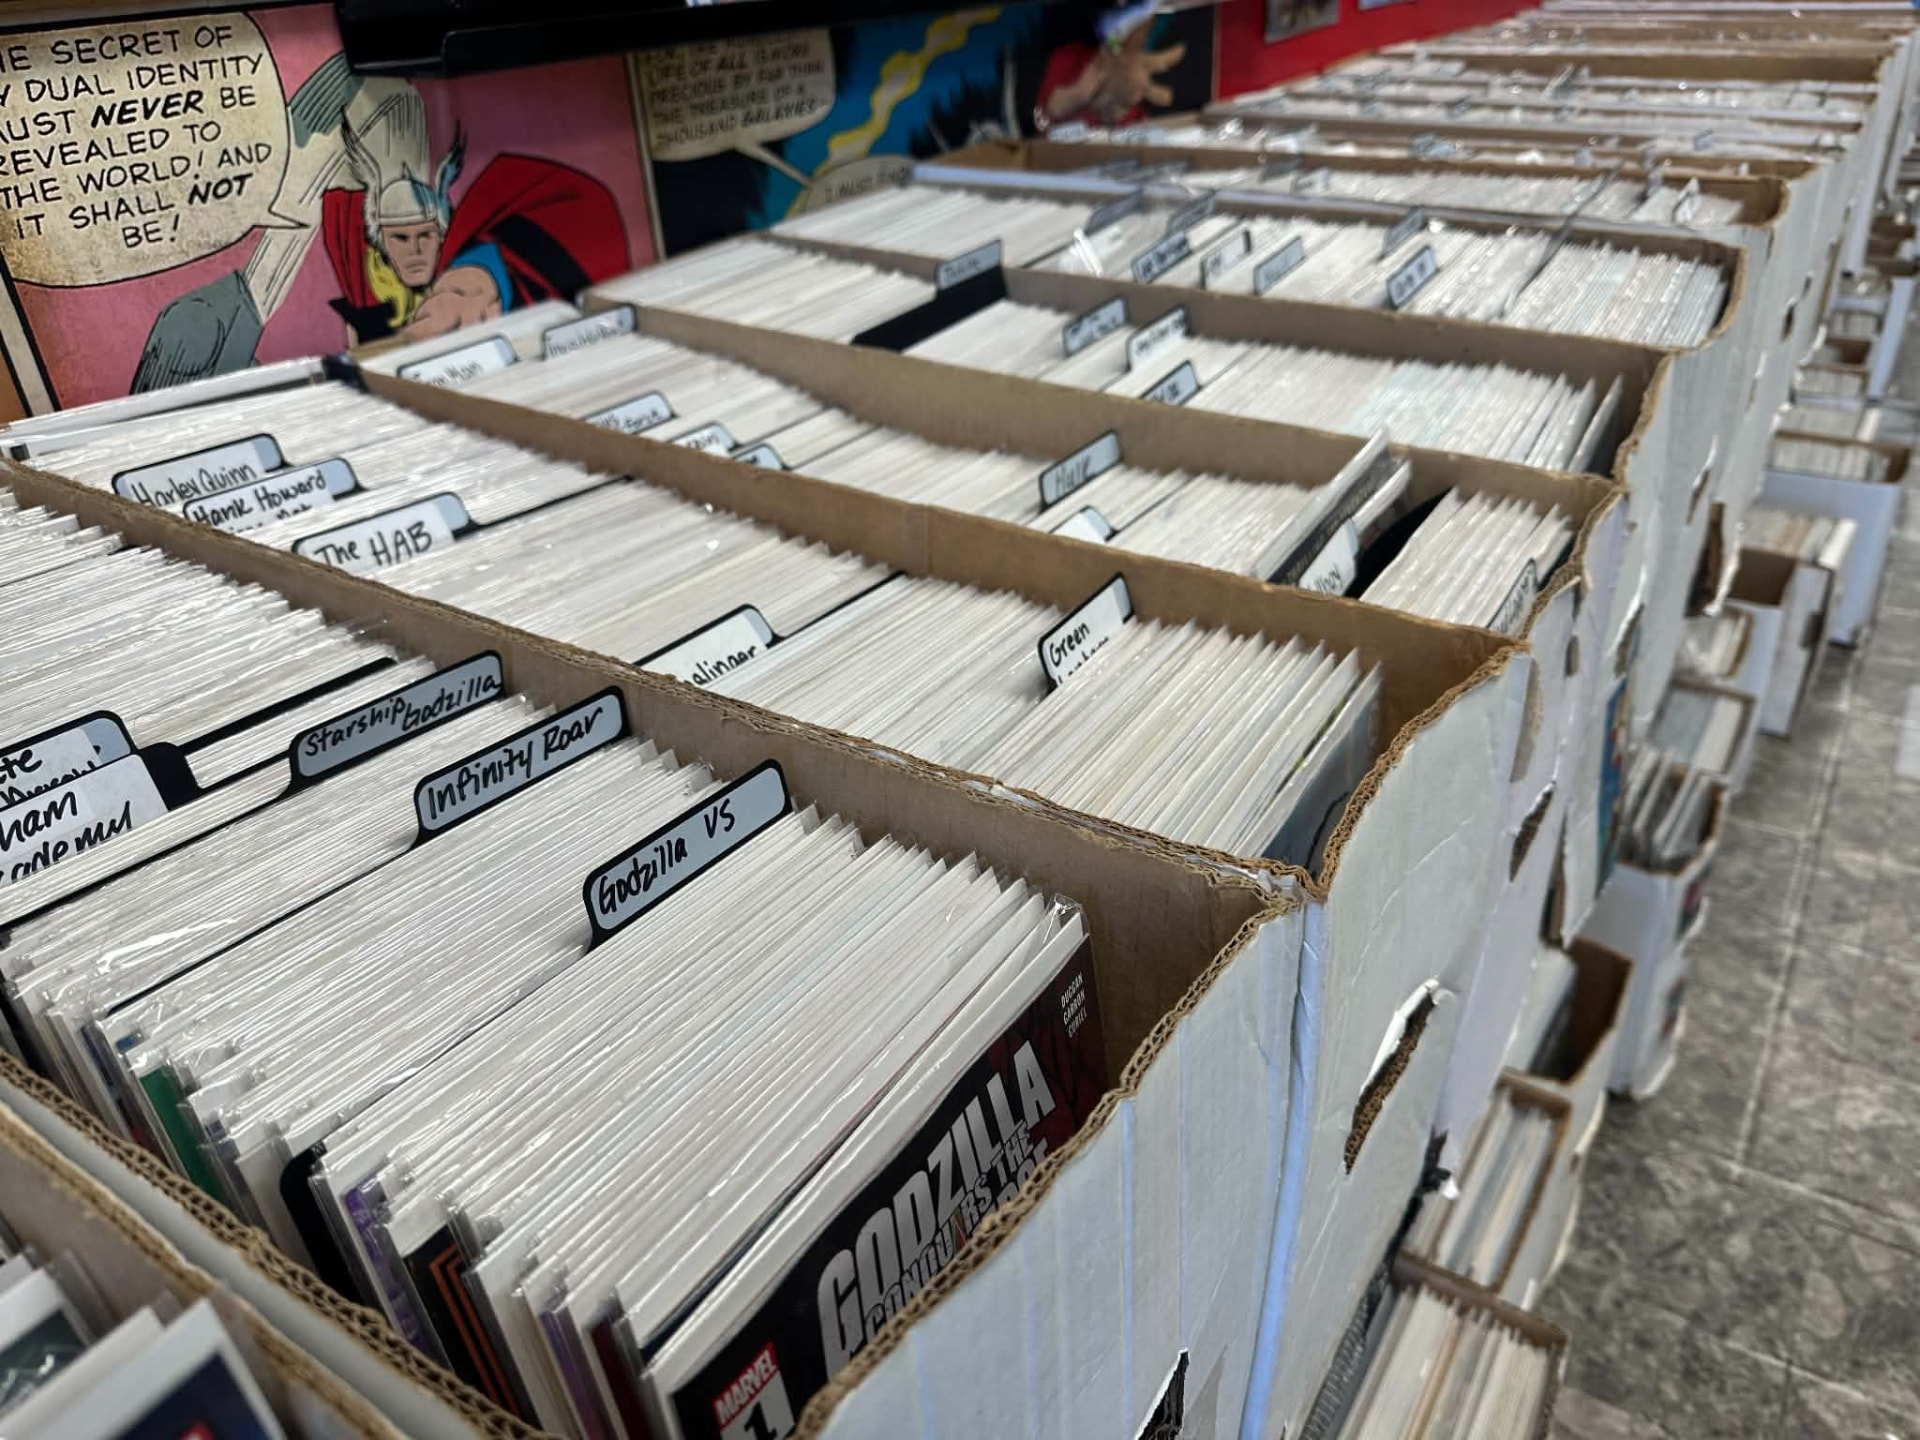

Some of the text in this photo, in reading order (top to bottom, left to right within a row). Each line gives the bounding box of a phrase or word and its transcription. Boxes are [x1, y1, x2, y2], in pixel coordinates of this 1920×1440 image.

[50, 29, 181, 65] SECRET
[194, 25, 233, 49] OF
[25, 74, 115, 103] DUAL
[126, 53, 263, 91] IDENTITY
[91, 89, 205, 129] NEVER
[220, 85, 257, 110] BE
[182, 121, 222, 145] TO
[0, 143, 272, 211] THE WORLD! AND
[16, 174, 253, 241] IT SHALL NOT
[122, 214, 181, 250] BE!
[131, 464, 258, 509] Harley Quinn
[192, 498, 253, 526] Hank
[254, 470, 326, 512] Howard
[313, 520, 432, 568] The HAB
[1050, 623, 1090, 667] Green
[402, 671, 502, 731] Godzilla
[428, 707, 604, 819] Infinity Roar
[600, 798, 736, 915] Godzilla VS
[817, 1040, 1056, 1380] GODZILLA
[714, 1349, 778, 1426] MARVEL
[744, 1401, 778, 1440] 1
